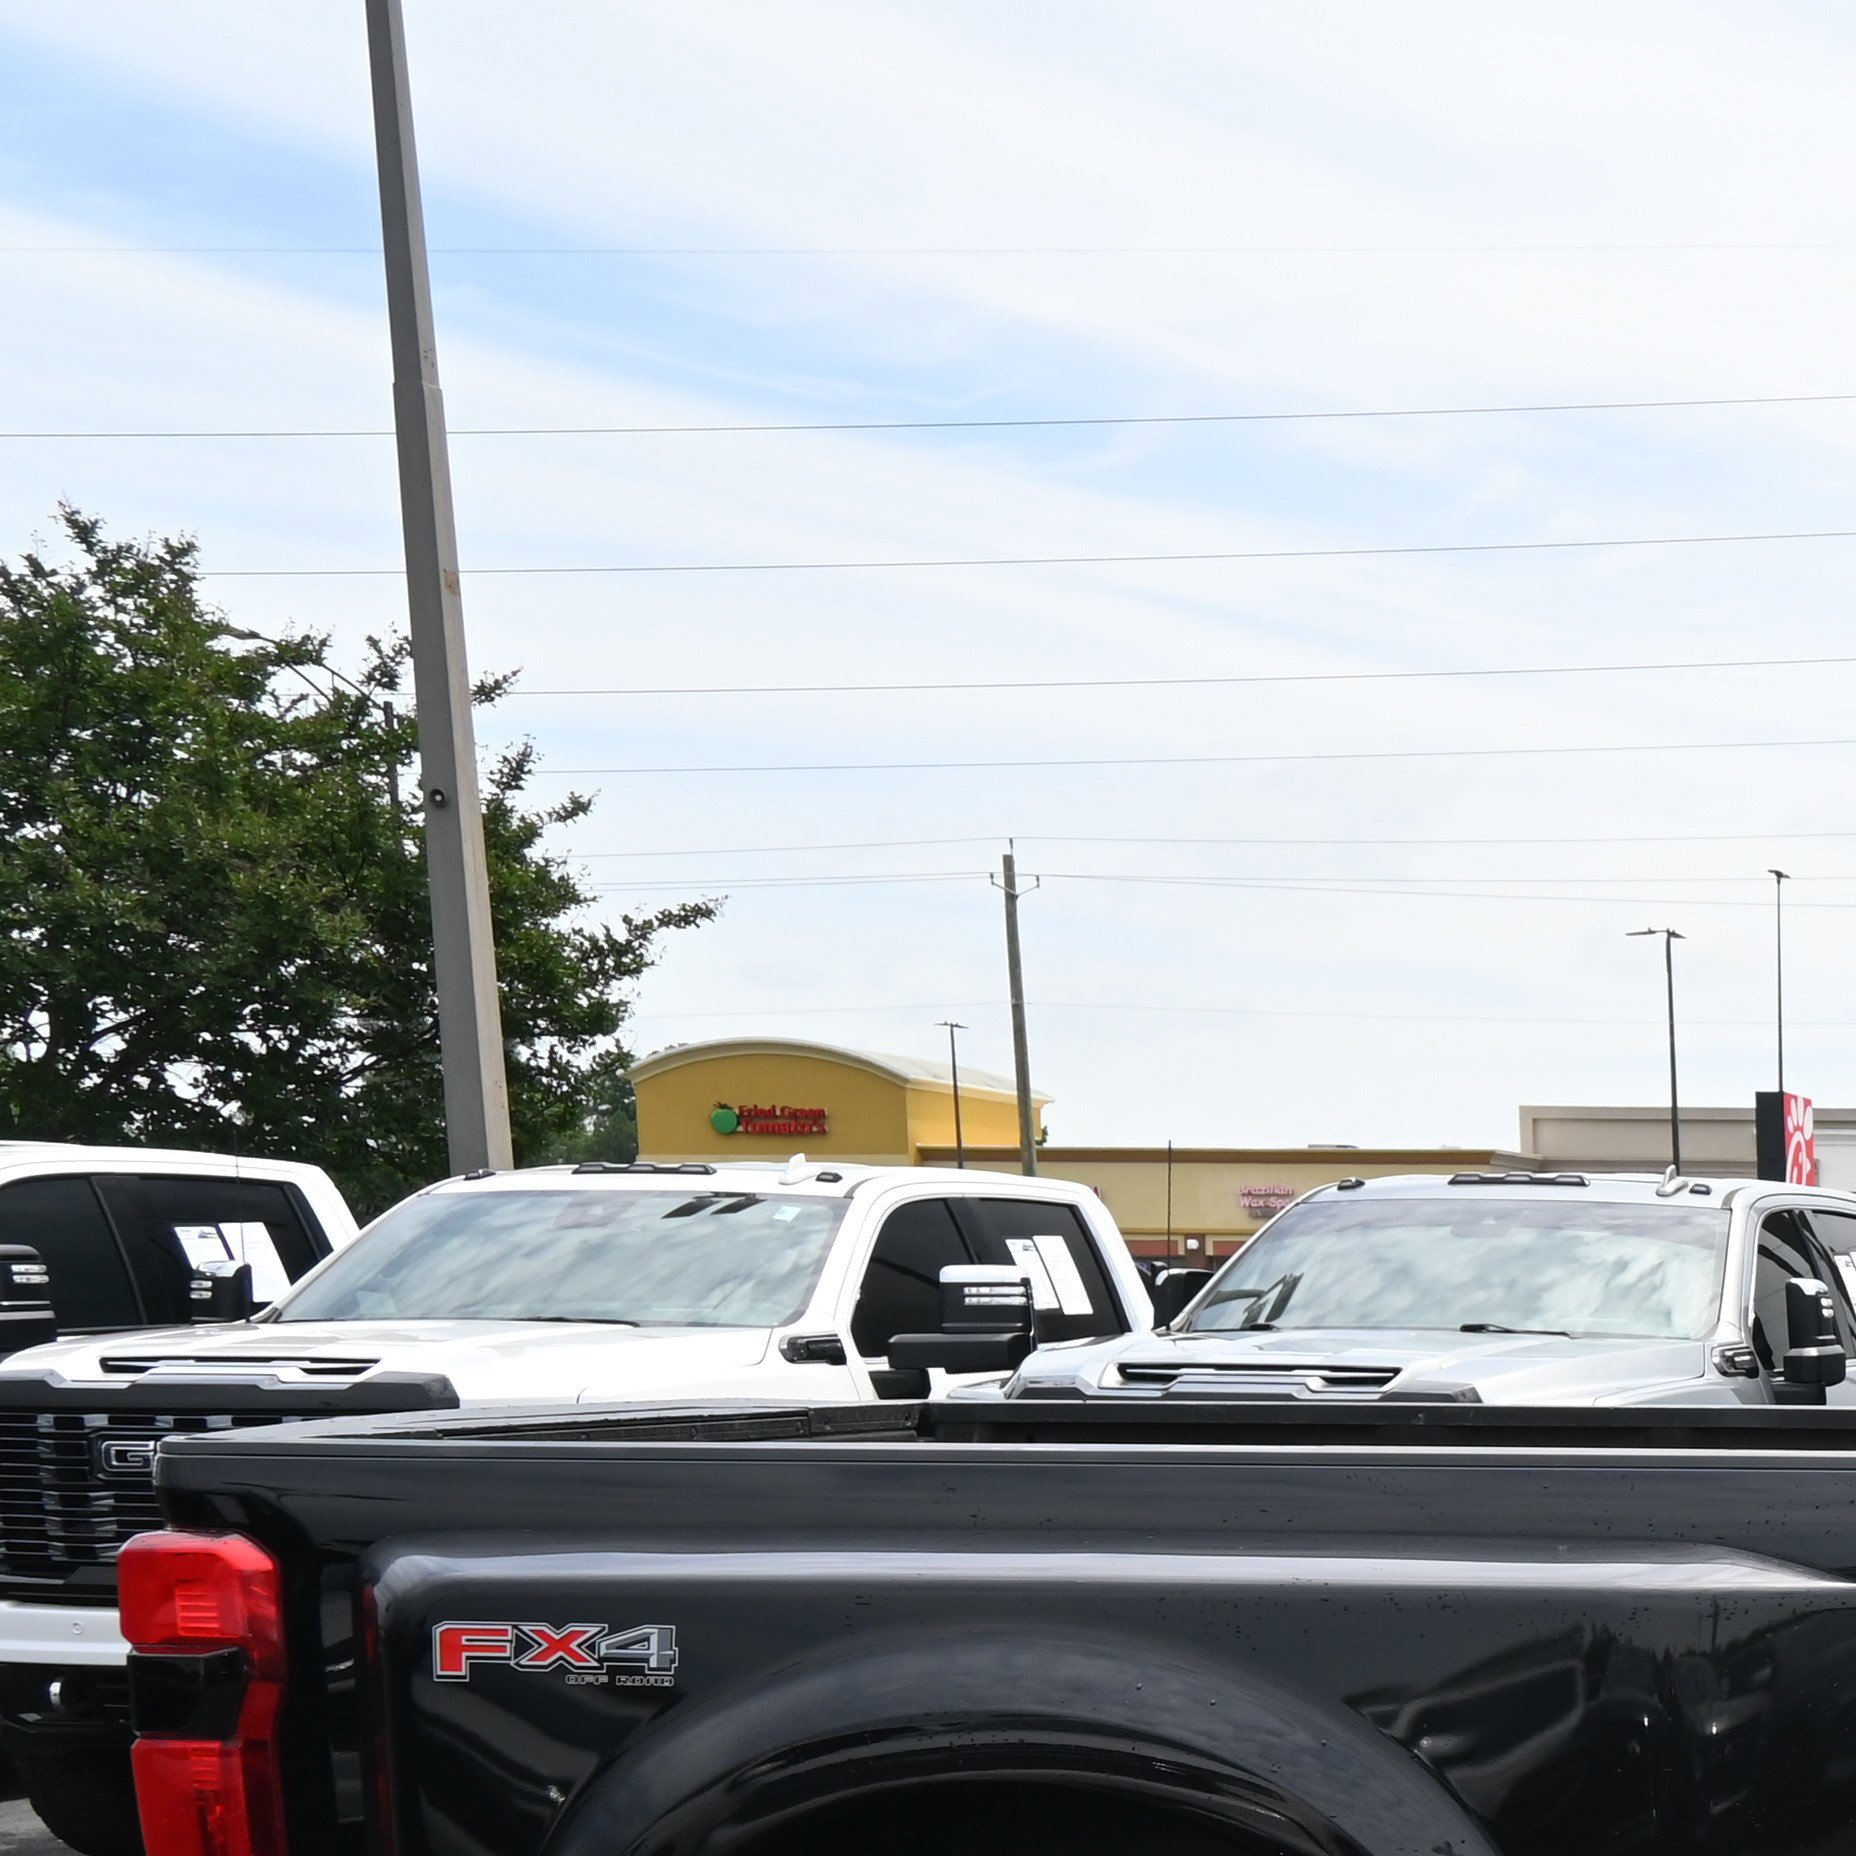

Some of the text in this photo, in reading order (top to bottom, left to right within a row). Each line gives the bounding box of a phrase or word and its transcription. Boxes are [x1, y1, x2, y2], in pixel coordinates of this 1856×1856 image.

[780, 1105, 826, 1118] Green
[432, 1621, 679, 1682] FX4
[565, 1674, 675, 1687] OFF ROAD
